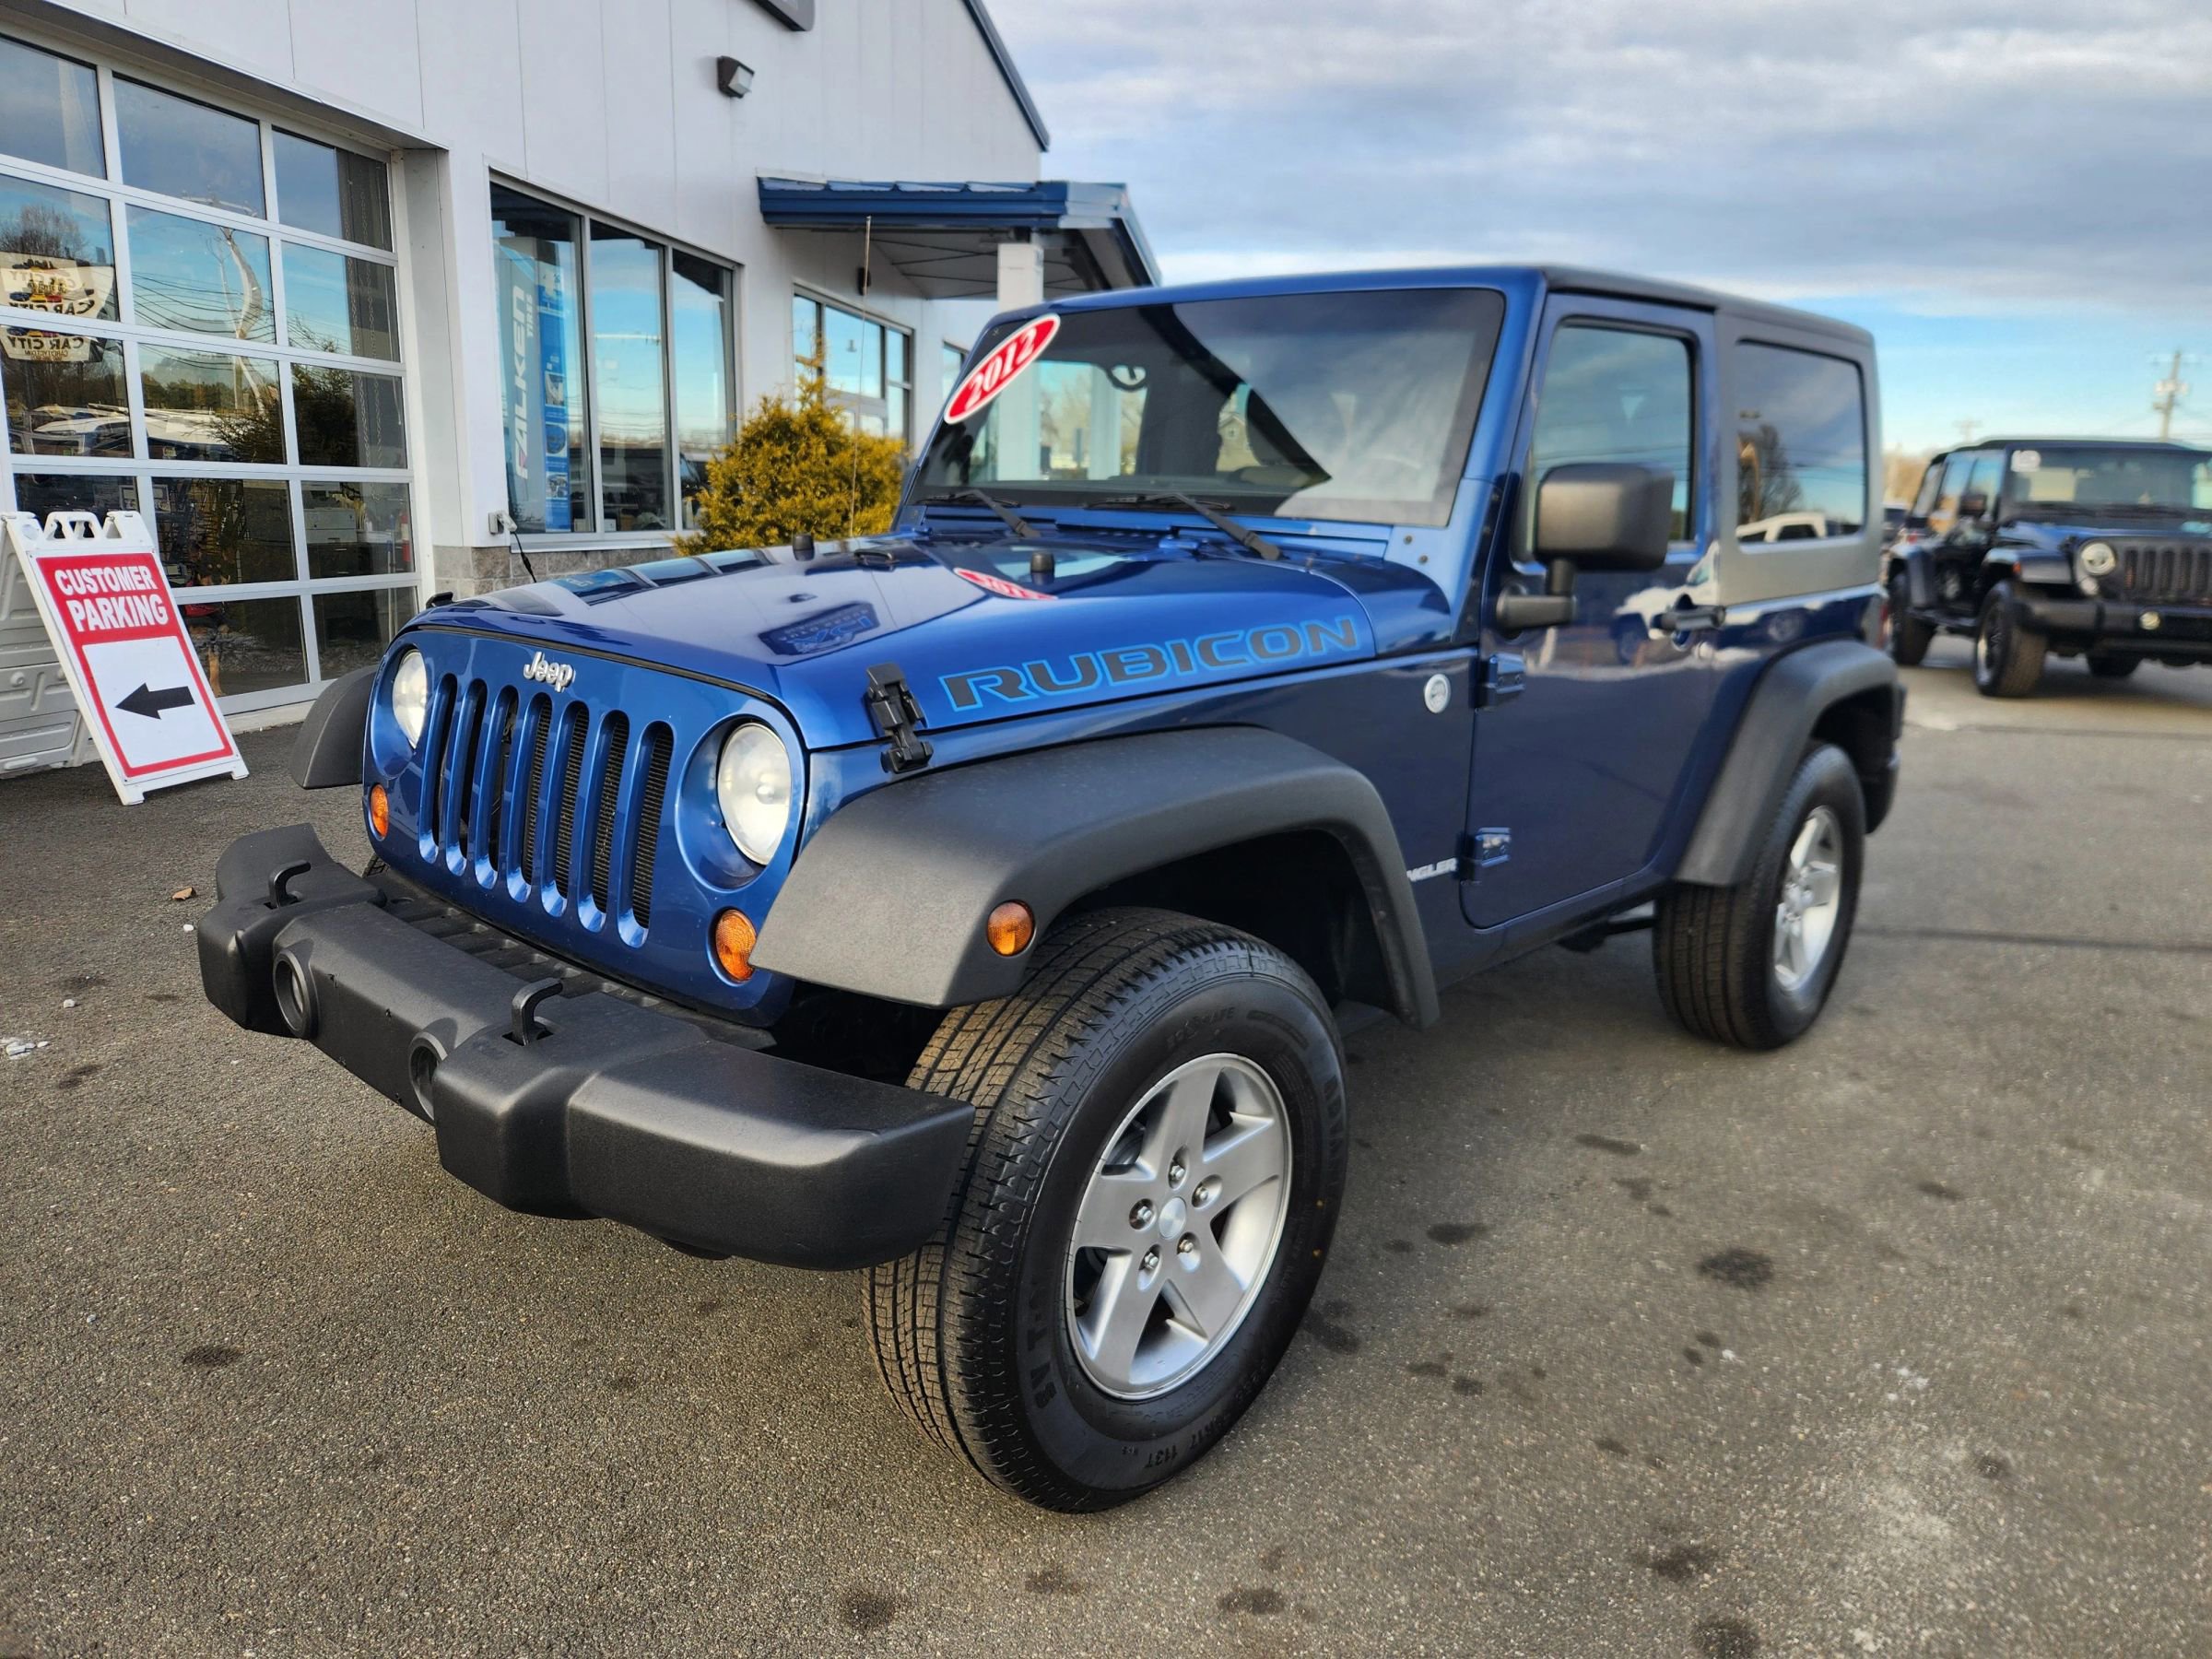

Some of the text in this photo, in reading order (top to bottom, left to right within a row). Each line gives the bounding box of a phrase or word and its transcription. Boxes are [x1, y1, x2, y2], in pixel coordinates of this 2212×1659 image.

[512, 285, 528, 480] FALKEN
[964, 325, 1038, 412] 2012
[53, 565, 159, 596] CUSTOMER
[65, 593, 170, 633] PARKING
[523, 651, 574, 693] Jeep
[938, 614, 1364, 713] RUBICON
